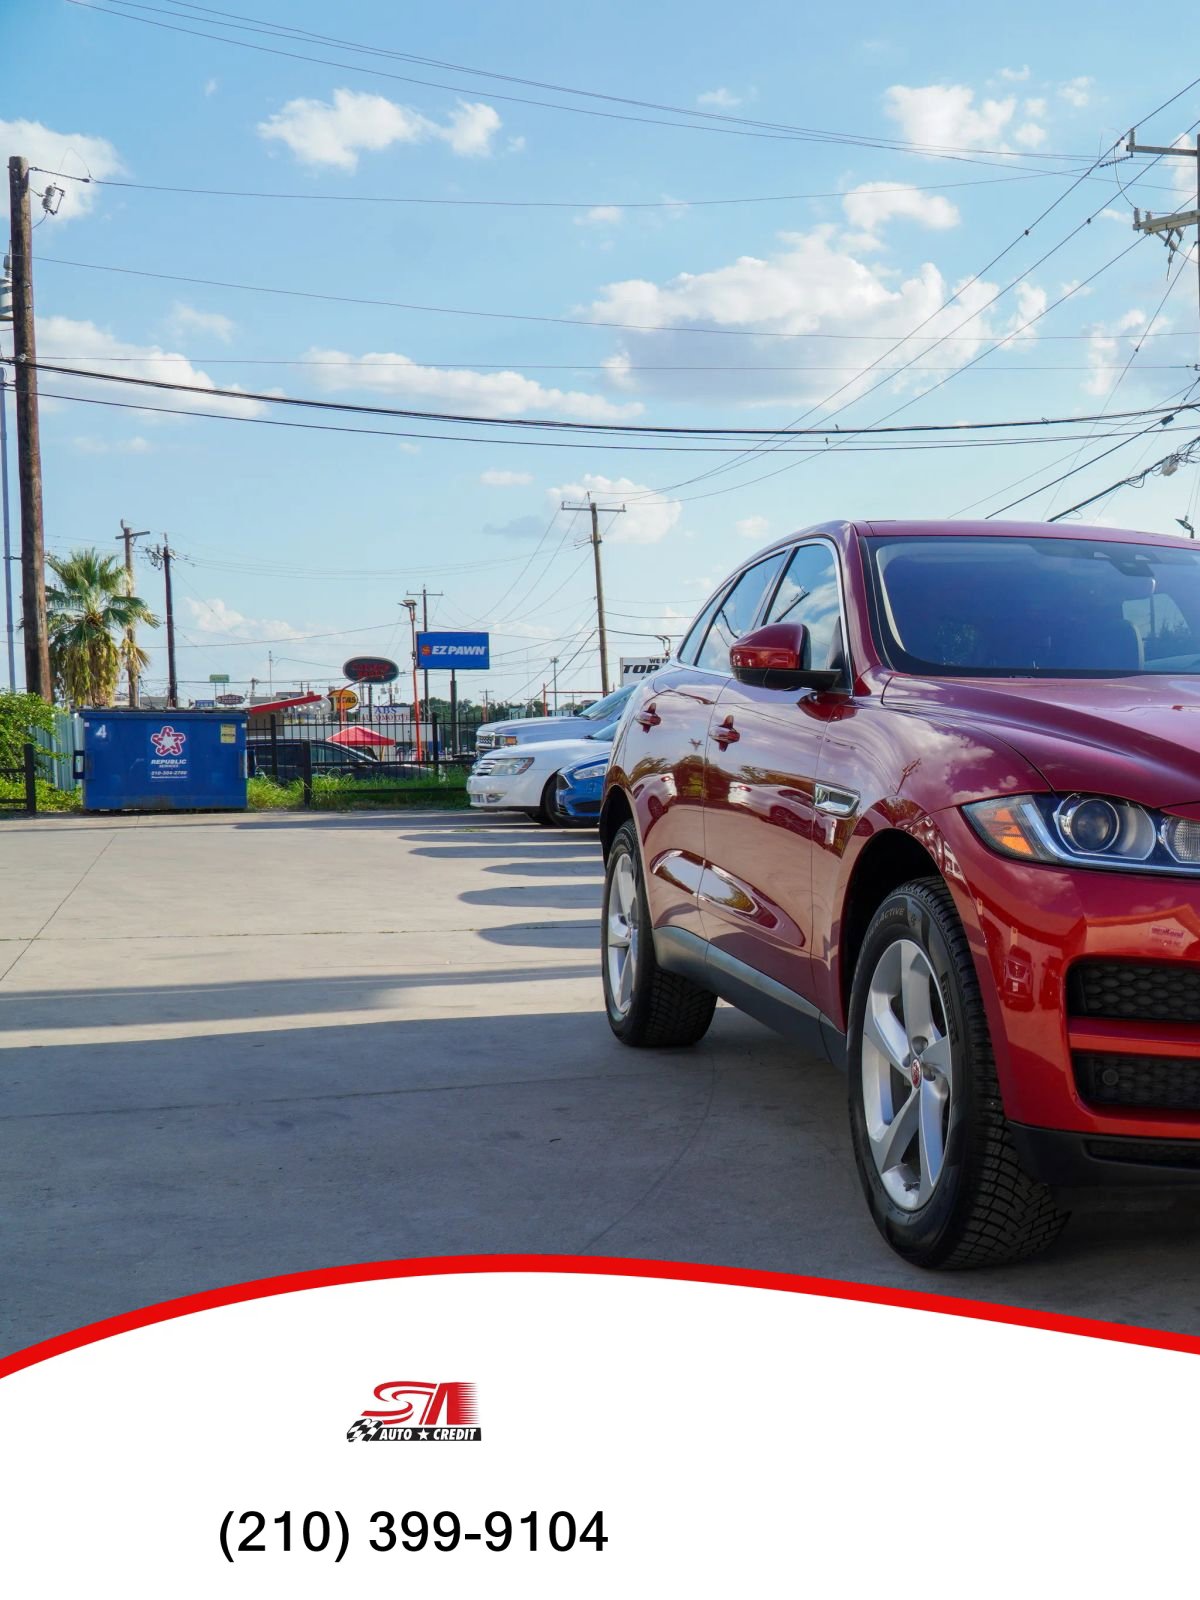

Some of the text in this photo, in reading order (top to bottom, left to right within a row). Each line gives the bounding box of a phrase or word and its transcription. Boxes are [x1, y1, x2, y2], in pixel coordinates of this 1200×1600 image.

[431, 645, 486, 656] EZ PAWN
[375, 706, 397, 714] ABS
[95, 724, 107, 738] 4
